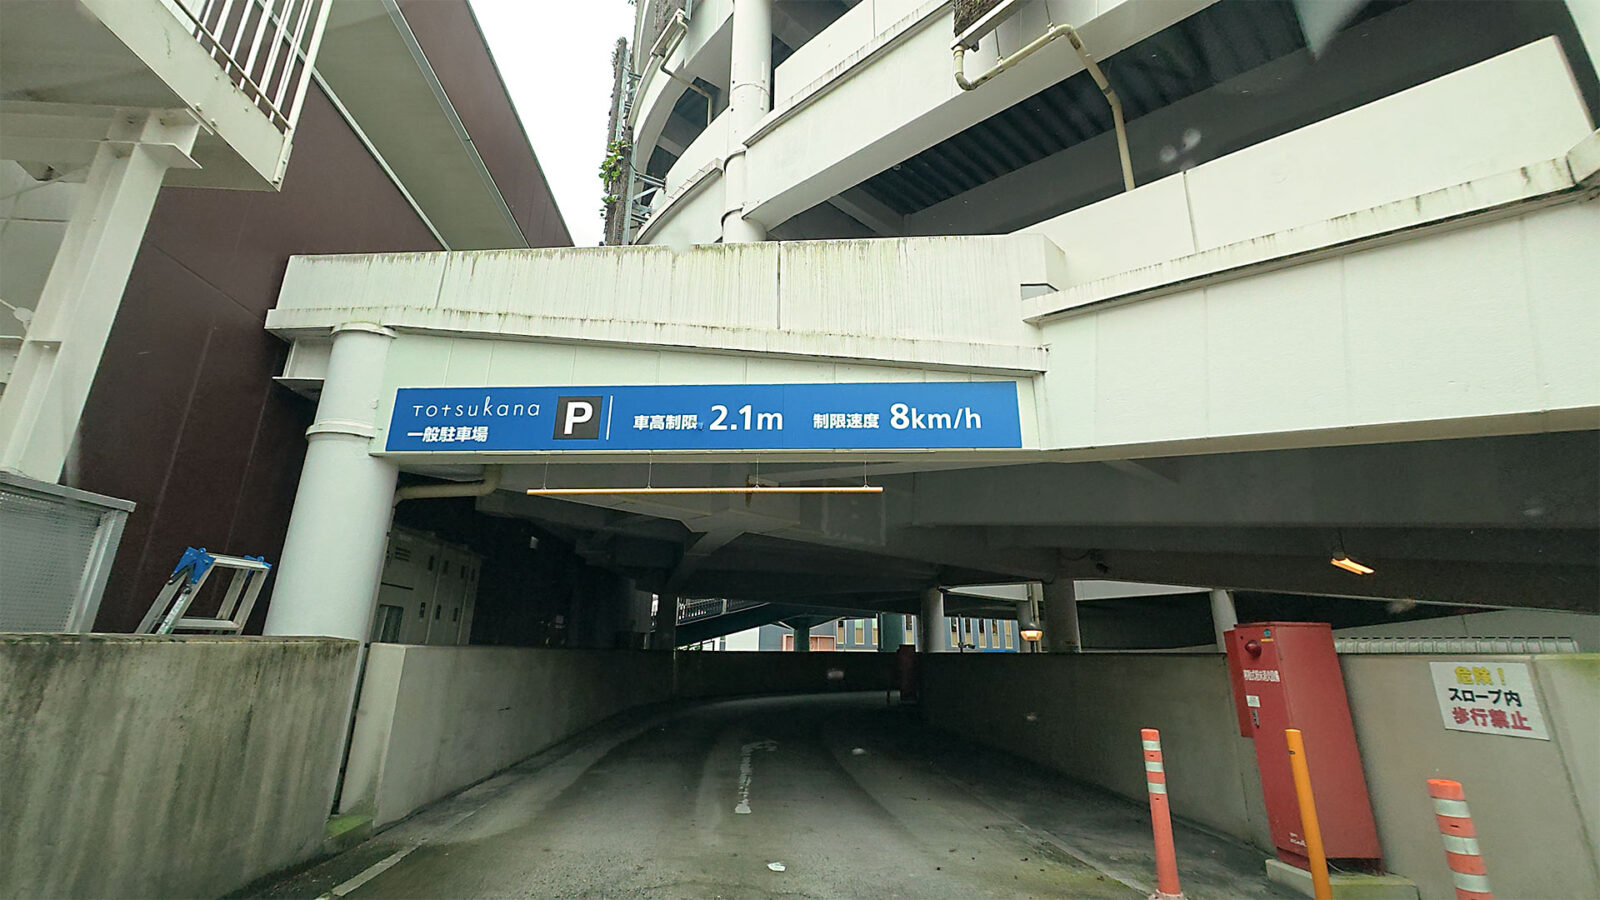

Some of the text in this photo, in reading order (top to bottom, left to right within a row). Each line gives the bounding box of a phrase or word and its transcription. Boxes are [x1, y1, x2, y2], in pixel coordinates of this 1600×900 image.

[564, 402, 593, 435] P
[633, 403, 982, 432] 車高制限 2.1m 制限速度 8km/h
[407, 426, 488, 443] 一般駐車場
[1448, 688, 1522, 707] スロープ内
[1452, 706, 1532, 731] 歩行禁止
